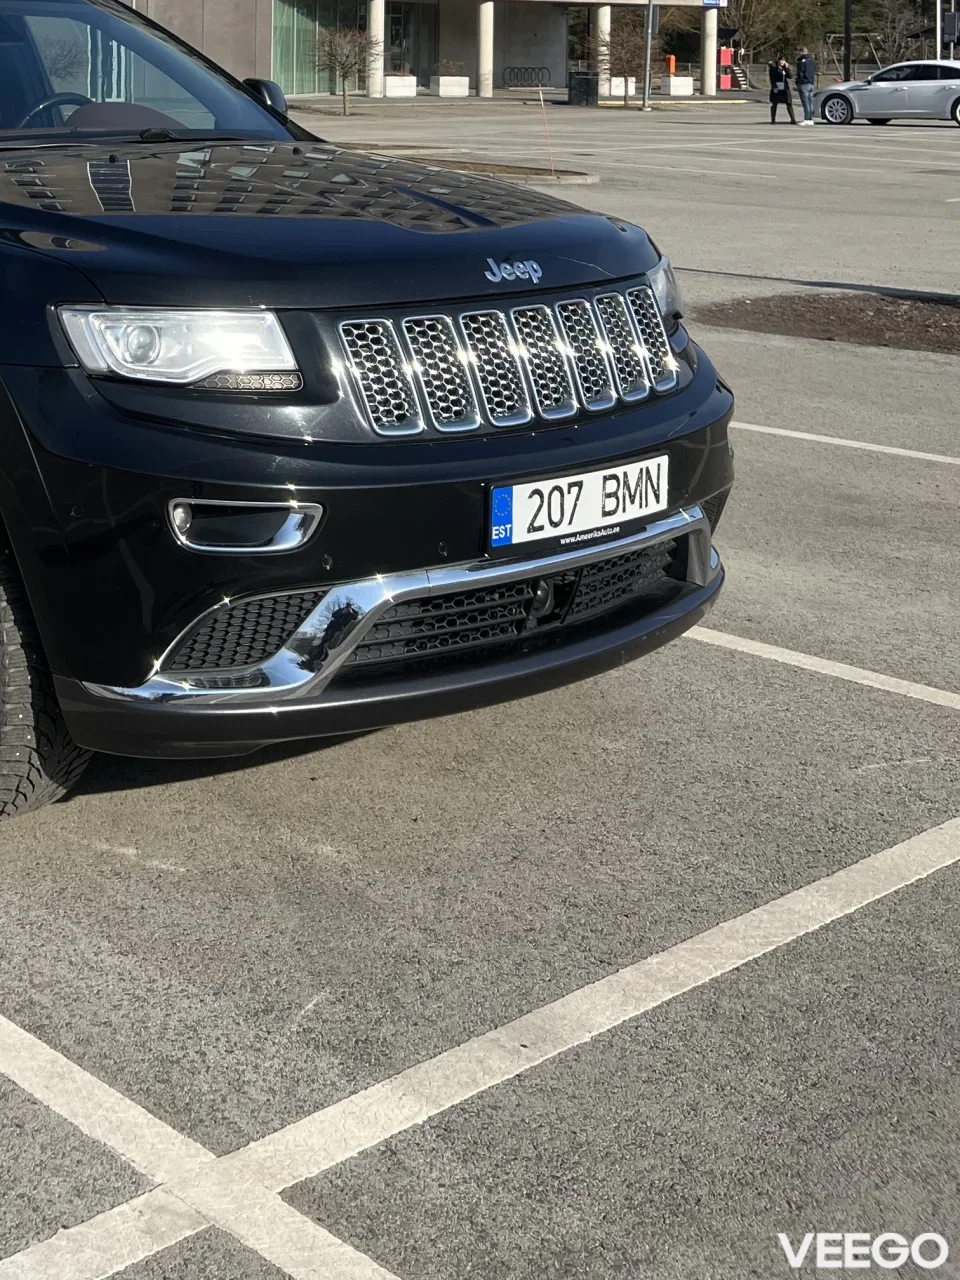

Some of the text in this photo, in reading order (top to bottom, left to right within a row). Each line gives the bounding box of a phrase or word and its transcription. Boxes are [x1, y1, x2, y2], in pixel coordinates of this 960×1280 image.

[484, 257, 543, 284] Jeep
[527, 463, 661, 534] 207 BMN
[492, 524, 512, 539] EST
